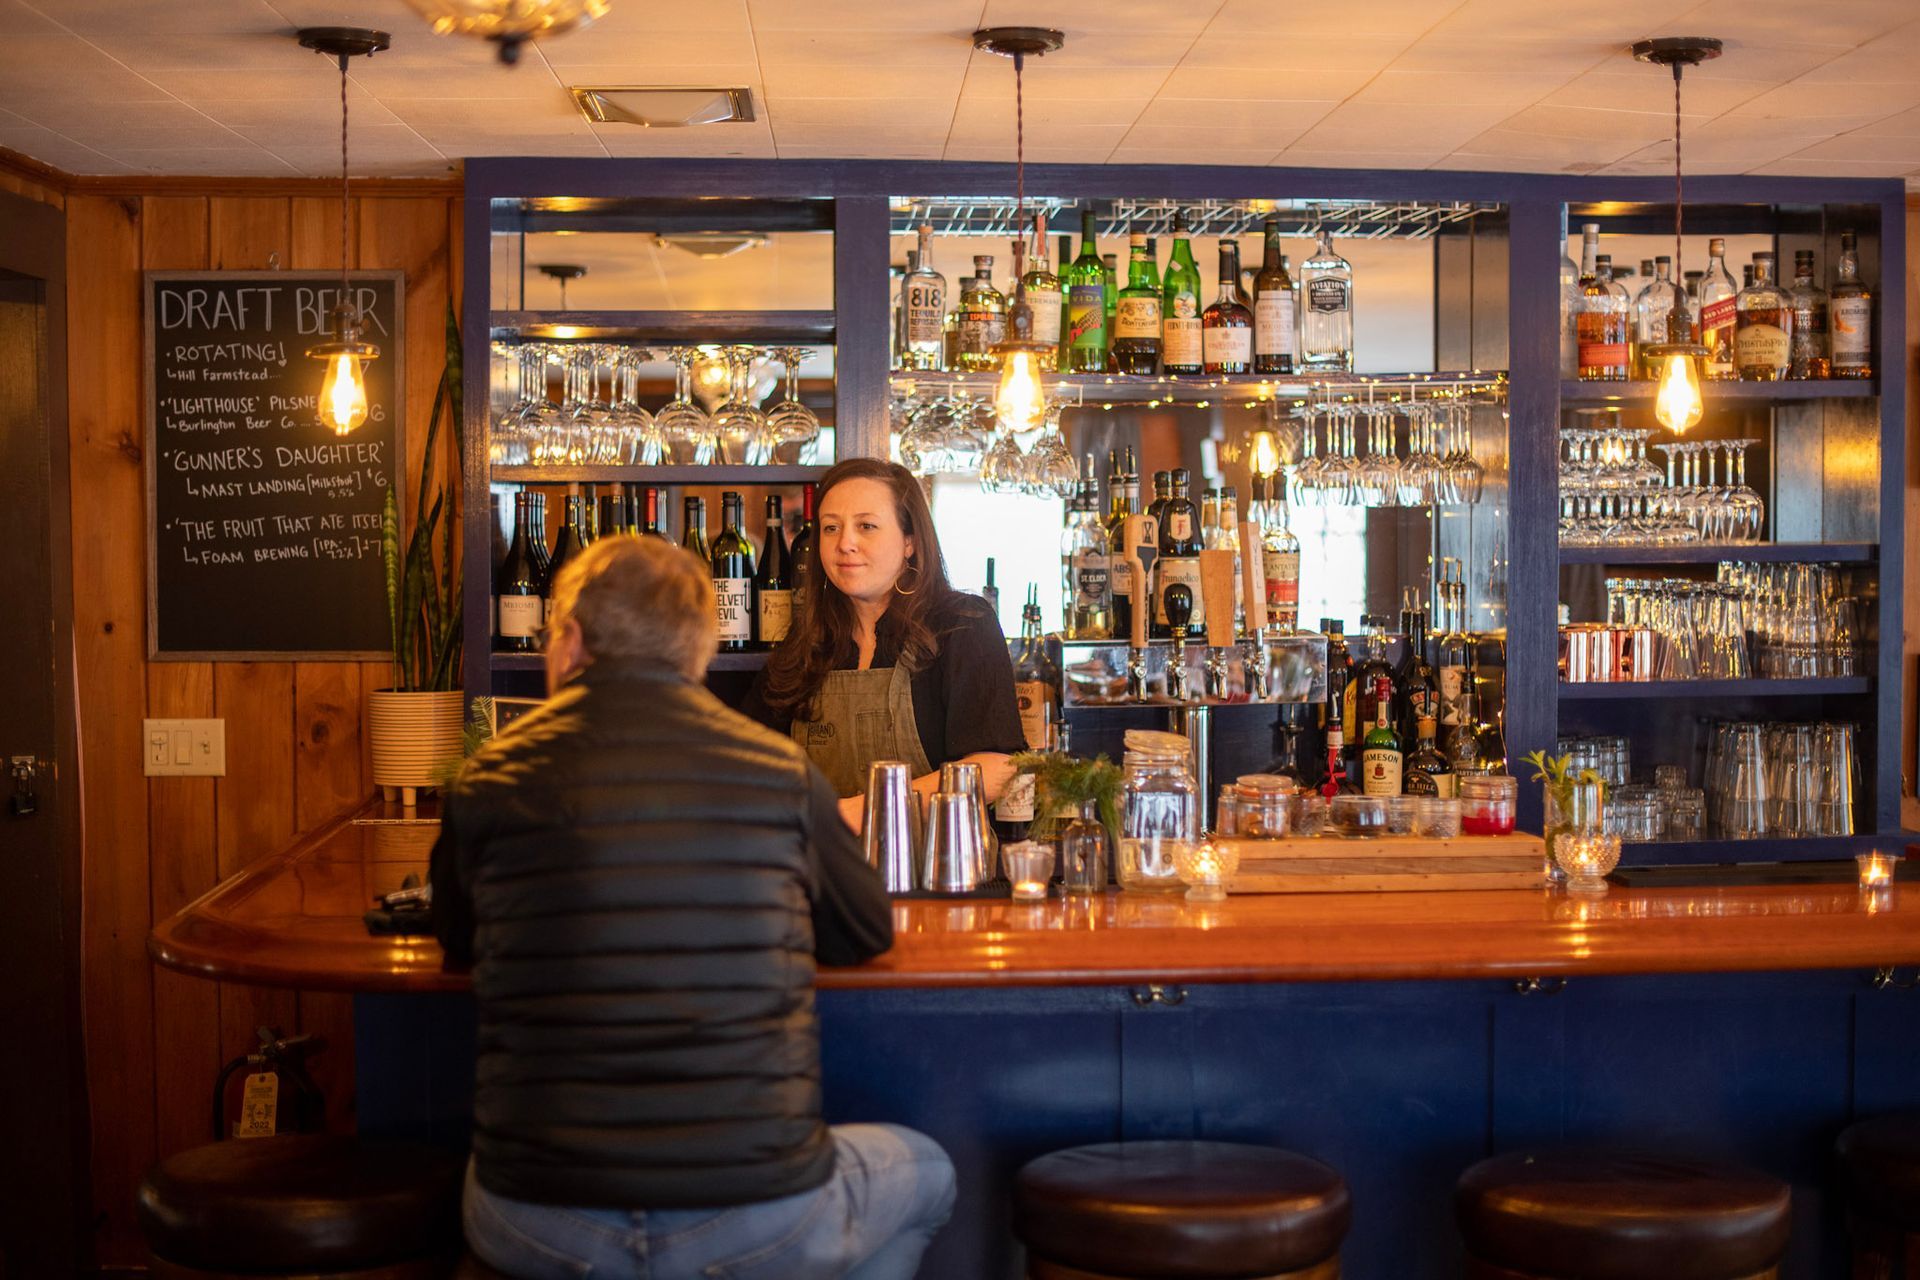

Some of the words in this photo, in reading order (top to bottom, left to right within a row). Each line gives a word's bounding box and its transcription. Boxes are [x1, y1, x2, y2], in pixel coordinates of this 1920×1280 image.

[1310, 281, 1345, 290] AVIATION
[911, 288, 942, 308] 818
[160, 286, 283, 332] DRAFT
[175, 342, 286, 367] ROTATING!
[177, 369, 196, 382] Hill
[269, 394, 317, 412] PILSNE
[178, 418, 236, 436] Burlington
[246, 415, 272, 430] Beer
[202, 483, 243, 498] MAST
[249, 479, 306, 496] LANDING
[223, 516, 266, 540] FRUIT
[273, 514, 314, 535] THAT
[320, 513, 346, 530] ATE
[202, 550, 245, 566] FOAM
[254, 545, 309, 563] BREWING
[713, 580, 729, 592] THE
[1161, 570, 1200, 585] Frangelico
[717, 607, 738, 620] EVIL
[1364, 753, 1399, 765] JAMESON
